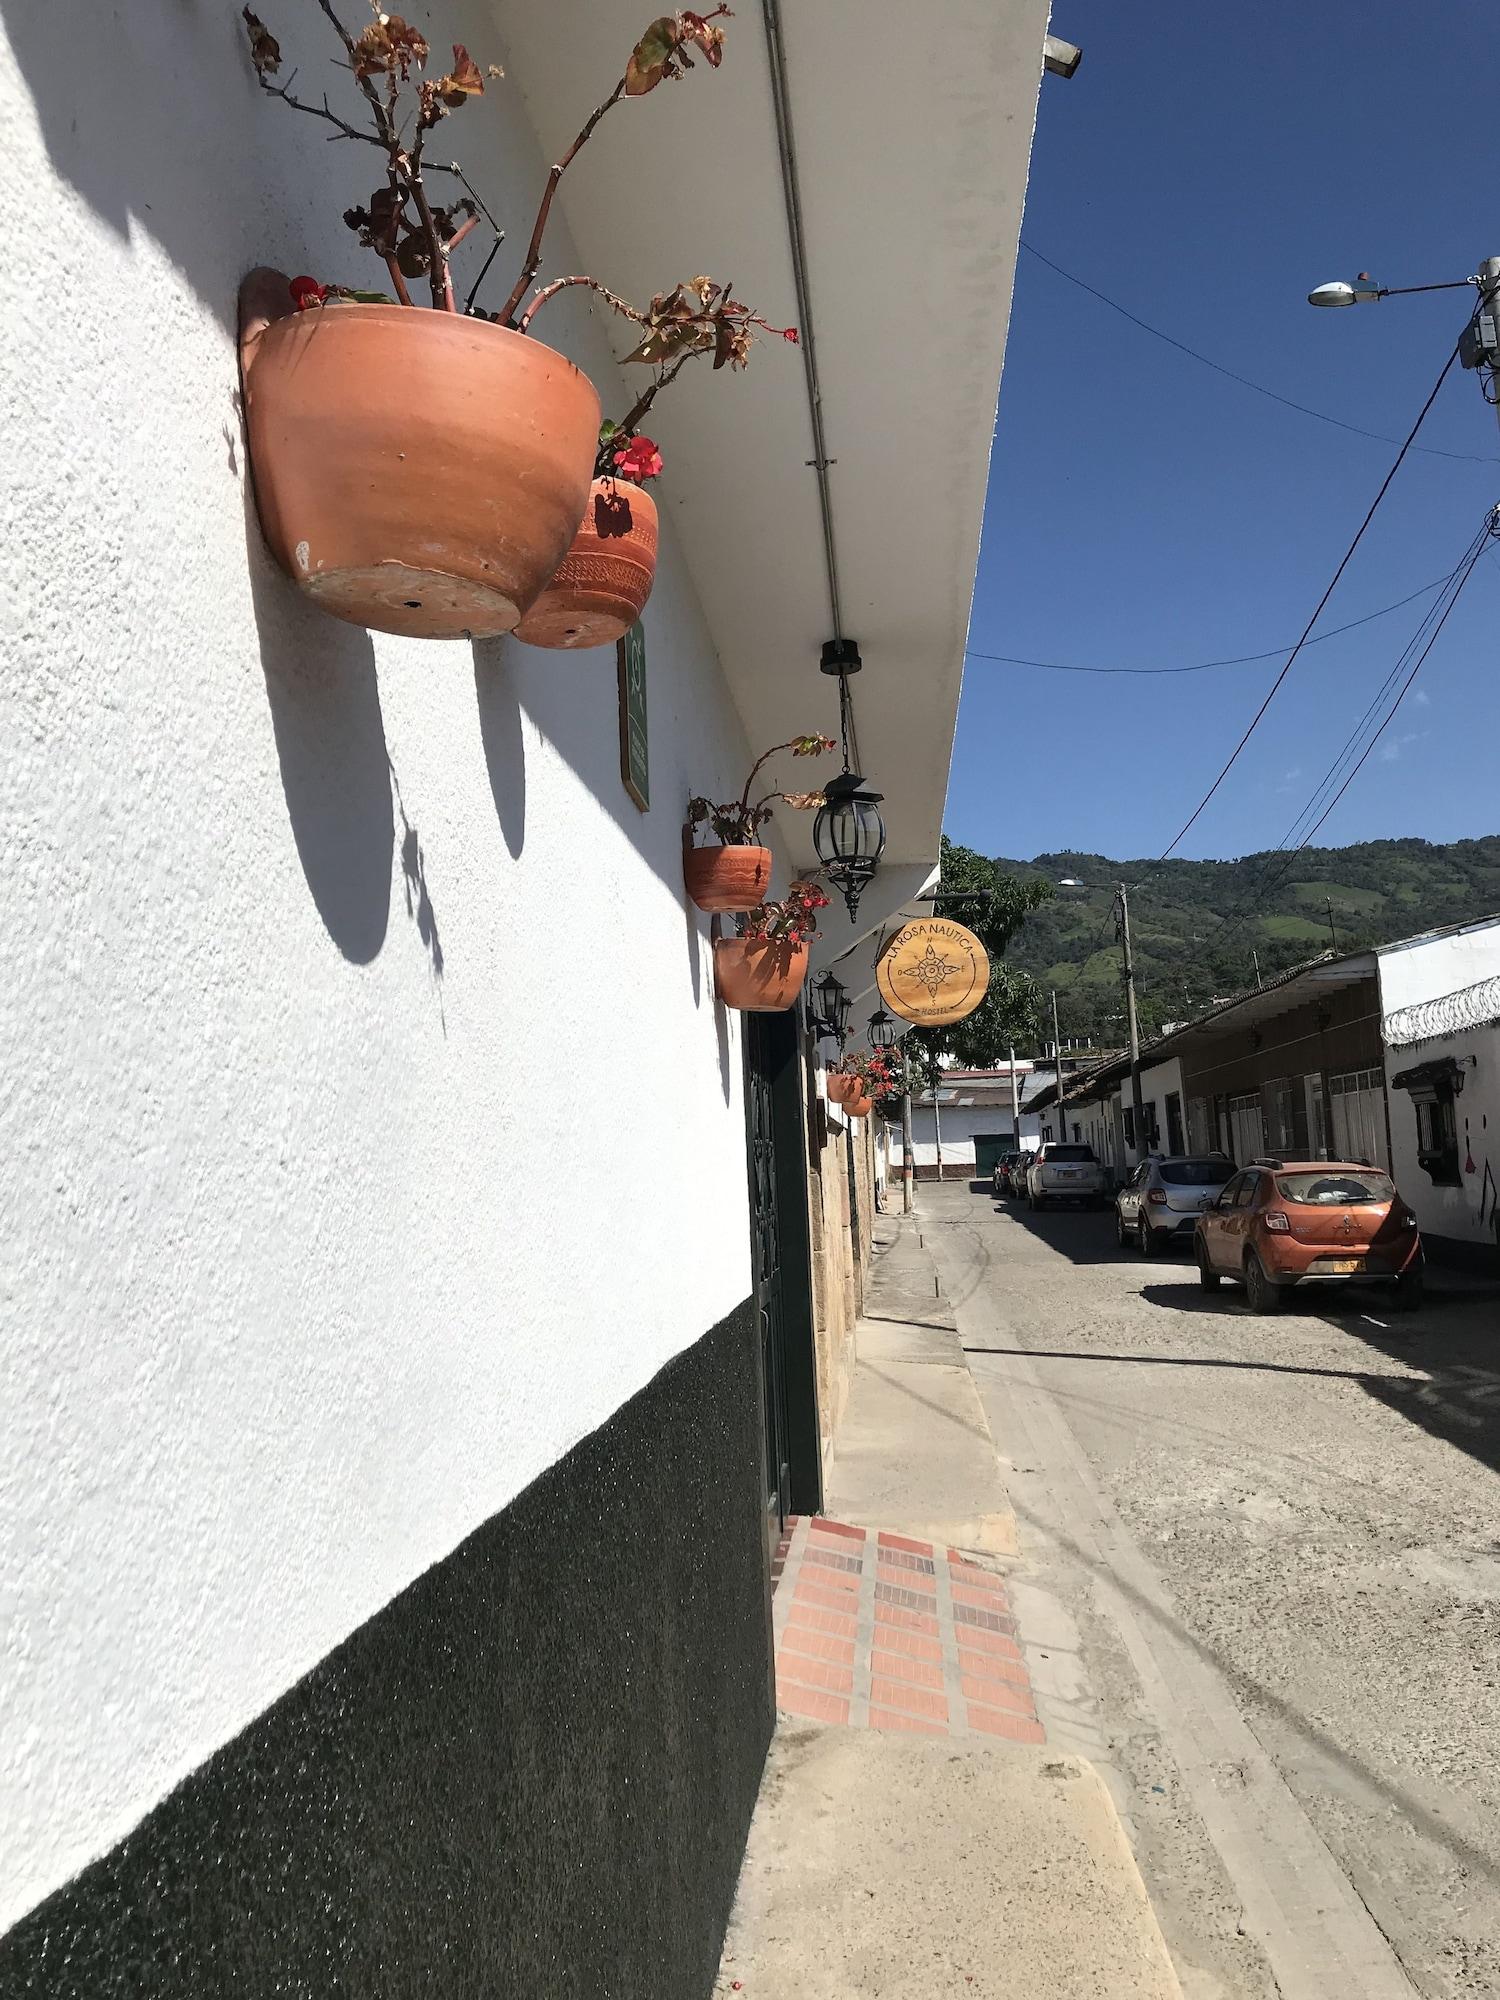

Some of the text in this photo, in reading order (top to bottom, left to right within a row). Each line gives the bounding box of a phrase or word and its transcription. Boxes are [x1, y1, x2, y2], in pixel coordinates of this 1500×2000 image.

[887, 924, 974, 959] LA ROSA NAUTICA
[921, 1007, 948, 1015] HOSTEL
